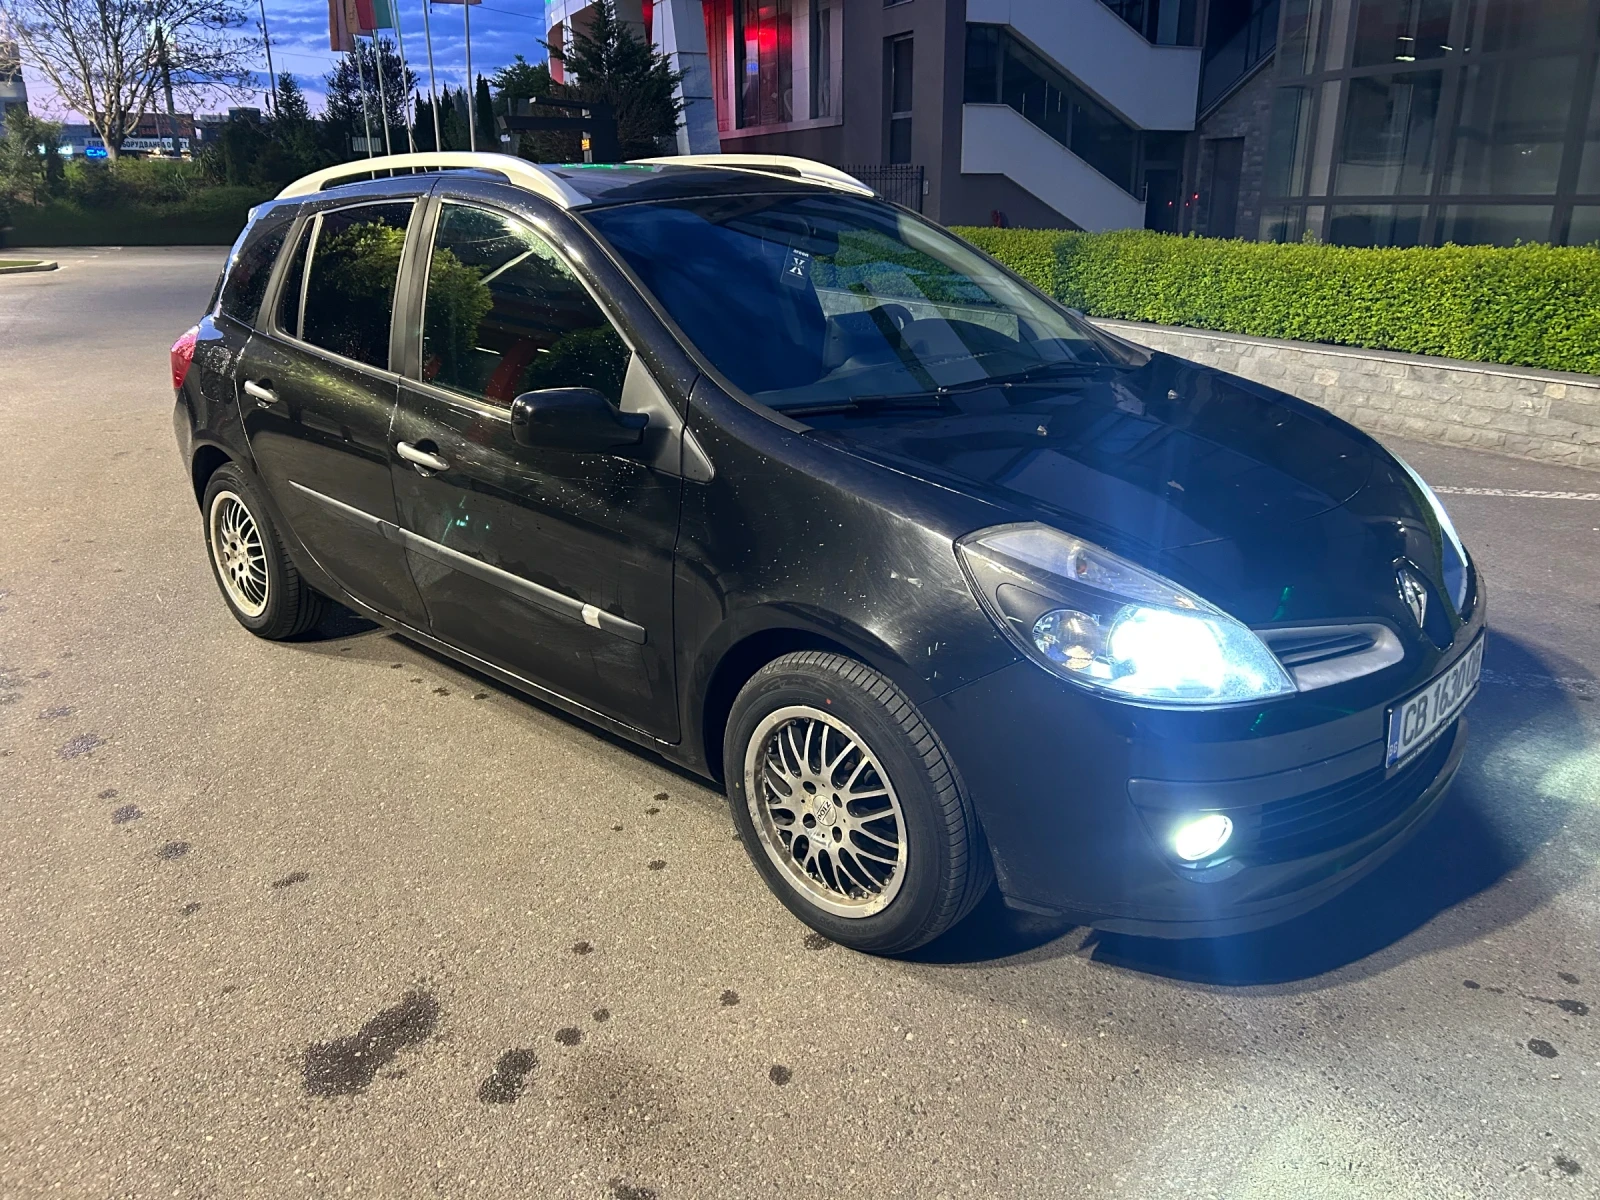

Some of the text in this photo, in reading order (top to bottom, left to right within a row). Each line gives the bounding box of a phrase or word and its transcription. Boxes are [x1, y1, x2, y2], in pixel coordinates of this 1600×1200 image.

[1403, 695, 1428, 747] CB
[1432, 660, 1467, 724] 1630
[1388, 740, 1398, 758] BG
